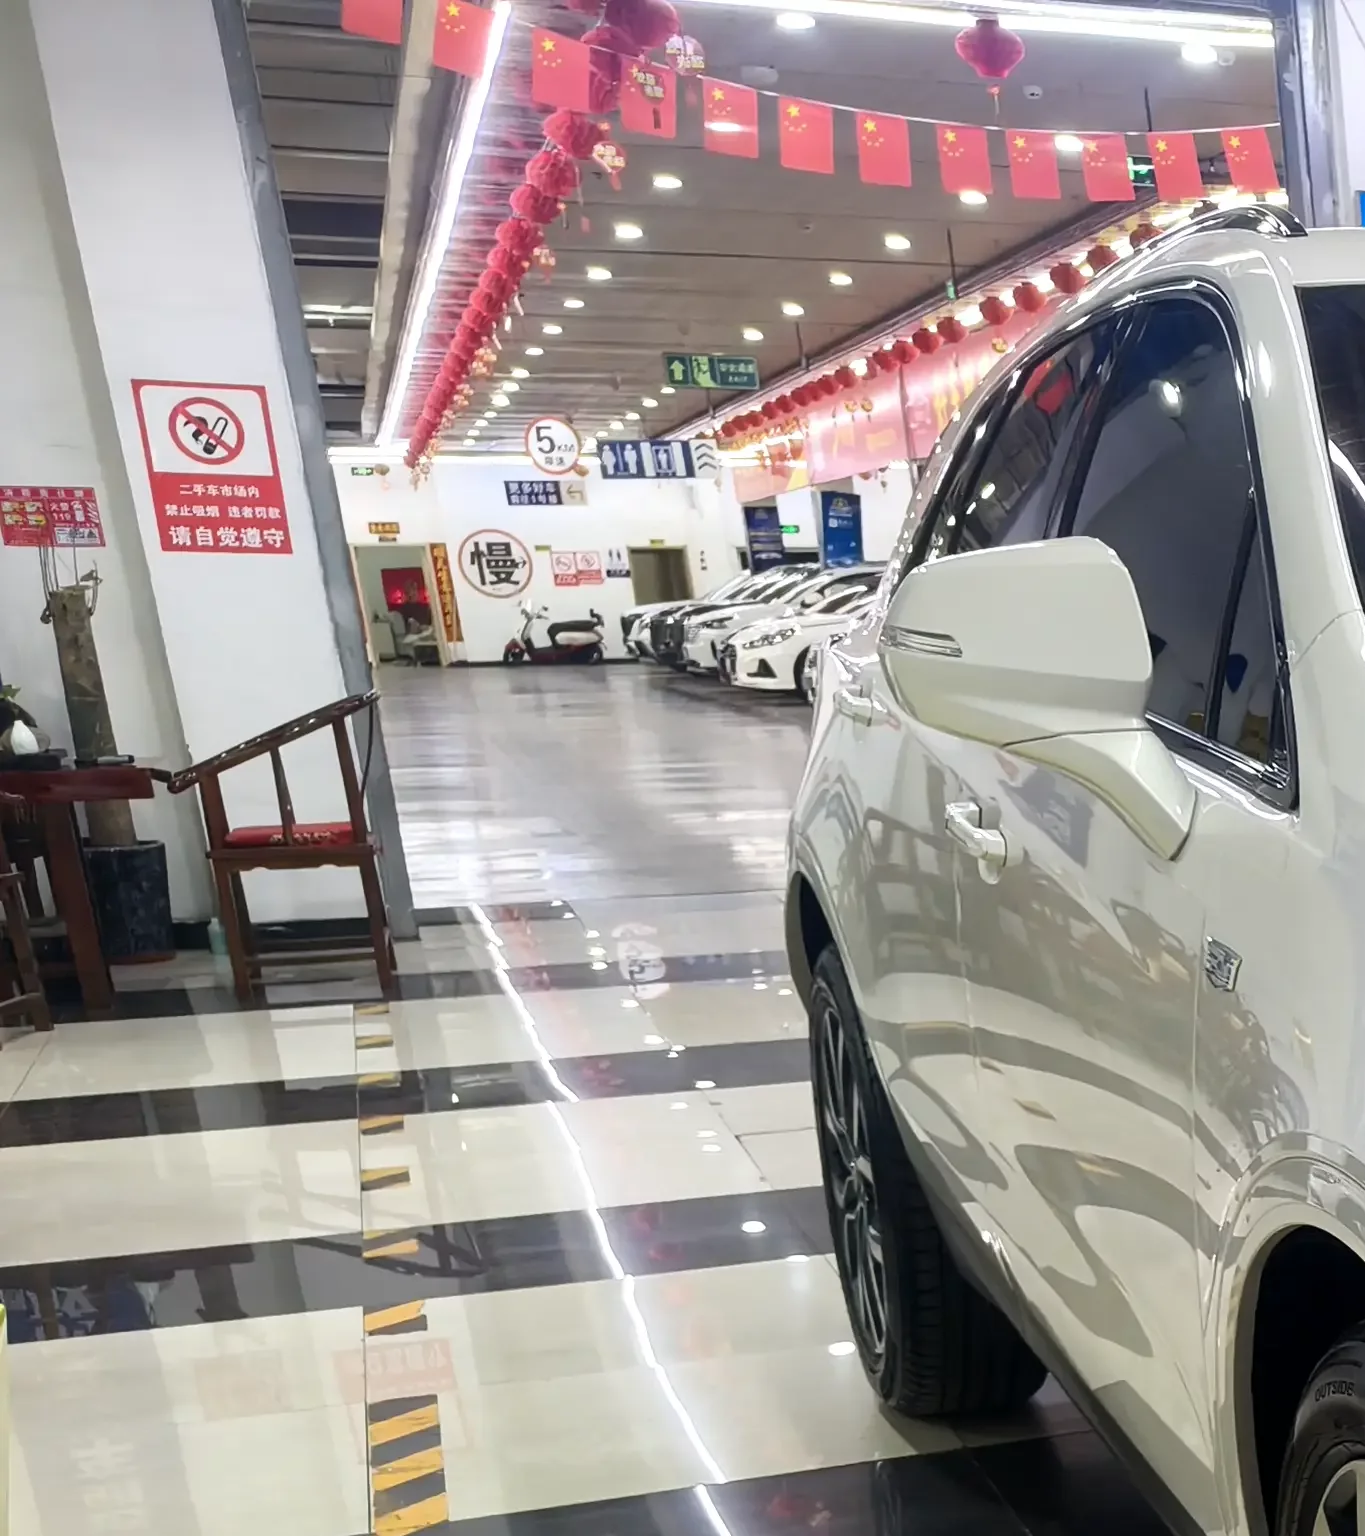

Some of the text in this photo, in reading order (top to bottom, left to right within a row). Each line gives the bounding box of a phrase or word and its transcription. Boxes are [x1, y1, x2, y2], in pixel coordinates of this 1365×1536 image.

[179, 483, 260, 498] 二手车市场内
[168, 525, 285, 548] 请自觉遵守
[470, 541, 527, 586] 慢
[1314, 1380, 1355, 1402] OUTSIDE
